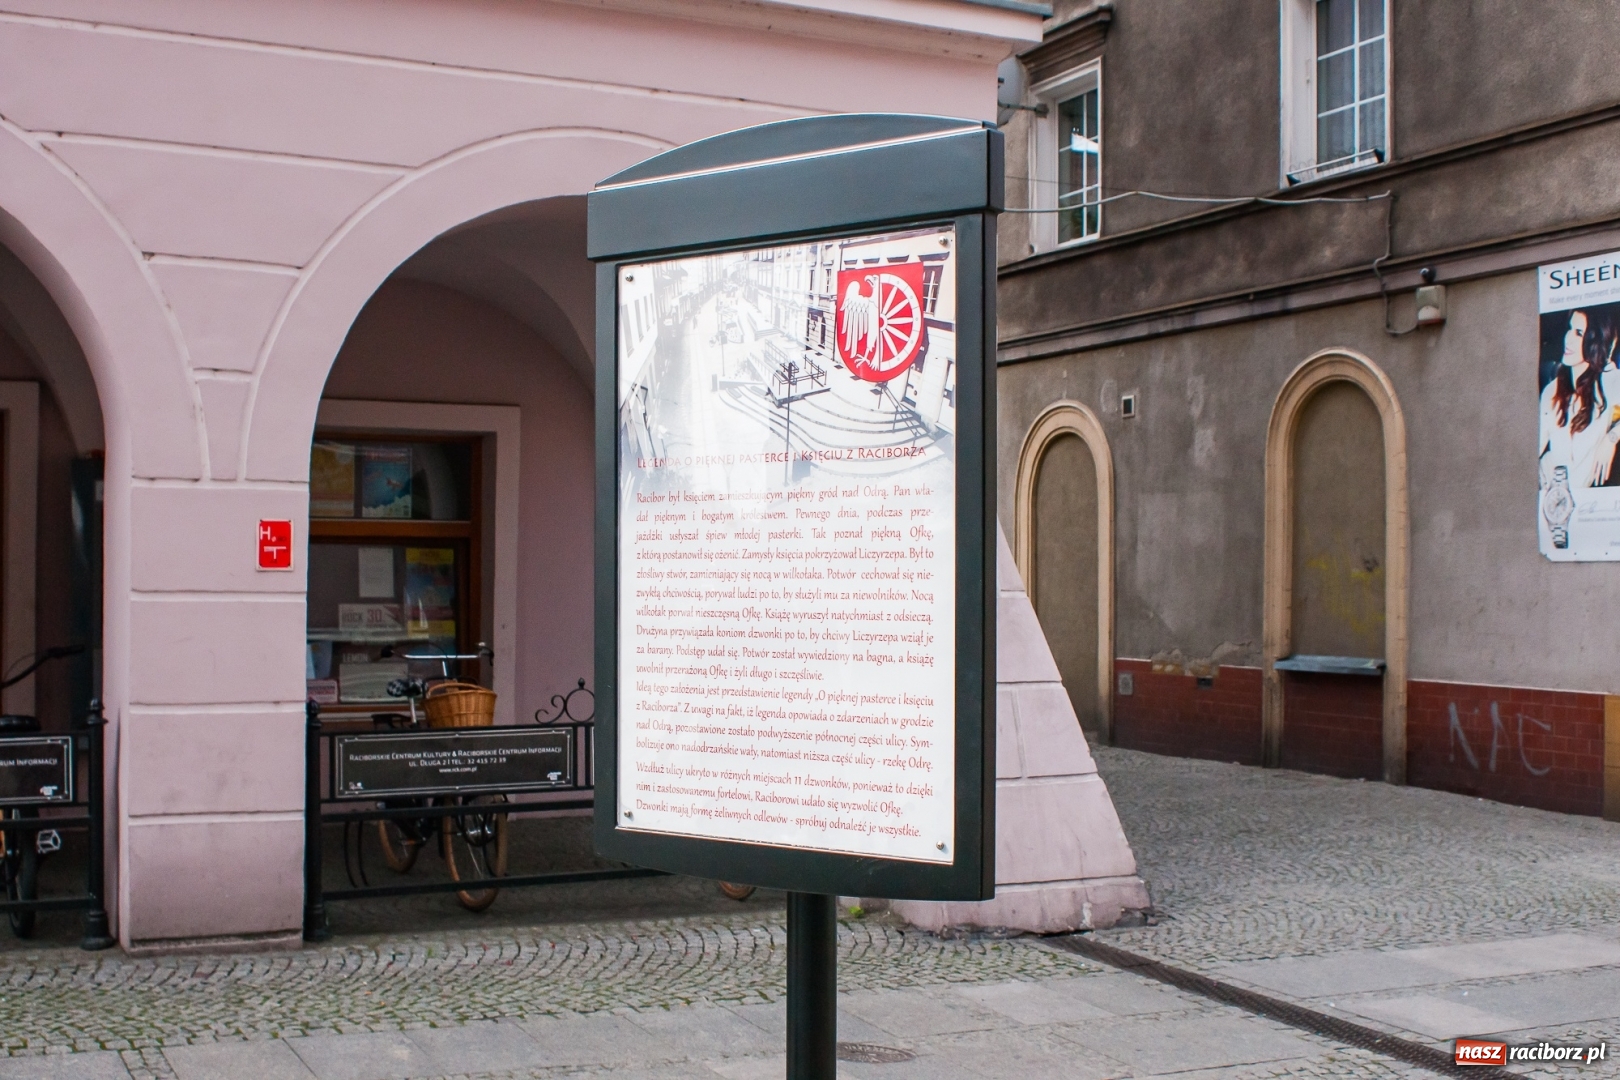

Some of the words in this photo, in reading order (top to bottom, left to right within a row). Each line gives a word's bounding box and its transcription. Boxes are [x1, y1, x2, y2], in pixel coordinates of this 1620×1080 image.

[636, 490, 665, 503] Racibor
[668, 490, 680, 506] był
[893, 484, 910, 496] Pan
[260, 526, 270, 540] H
[669, 528, 698, 544] usłyszał
[813, 526, 826, 538] Tak
[833, 525, 862, 542] poznał
[870, 525, 901, 541] piękną
[909, 524, 933, 541] Ofkę,
[641, 547, 661, 562] którą
[714, 548, 740, 559] ożenić.
[741, 546, 774, 563] Zamysły
[804, 546, 857, 562] pokrzyżował
[858, 547, 907, 562] Liczyrzepa.
[909, 545, 924, 562] Był
[666, 568, 687, 579] stwór,
[752, 571, 772, 582] nocą
[781, 566, 824, 579] wilkołaka.
[827, 568, 856, 579] Potwór
[860, 566, 900, 580] cechował
[636, 585, 661, 601] zwykłą
[737, 586, 757, 598] ludzi
[852, 587, 908, 601] niewolników.
[910, 589, 934, 604] Nocą
[635, 604, 666, 616] wilkołak
[741, 606, 762, 622] Ofkę.
[792, 606, 828, 624] wyruszył
[830, 607, 884, 625] natychmiast
[893, 608, 933, 625] odsieczą.
[636, 624, 668, 639] Drużyna
[669, 623, 714, 640] przywiązała
[716, 625, 746, 638] koniom
[747, 625, 782, 639] dzwonki
[852, 629, 898, 646] Liczyrzepa
[900, 629, 924, 646] wziął
[676, 643, 705, 659] Podstęp
[707, 644, 725, 657] udał
[742, 646, 770, 658] Potwór
[771, 646, 795, 659] został
[866, 649, 895, 667] bagna,
[906, 650, 934, 667] książę
[665, 663, 707, 678] przerażoną
[708, 663, 728, 680] Ofkę
[734, 664, 747, 681] żyli
[749, 665, 772, 682] długo
[778, 666, 824, 683] szczęśliwie.
[706, 684, 720, 699] jest
[721, 683, 780, 701] przedstawienie
[781, 686, 813, 704] legendy
[860, 692, 896, 708] pasterce
[903, 692, 934, 709] księciu
[690, 703, 714, 718] uwagi
[726, 703, 745, 720] fakt,
[755, 704, 786, 722] legenda
[787, 706, 827, 725] opowiada
[836, 709, 889, 725] zdarzeniach
[899, 712, 934, 731] grodzie
[674, 721, 726, 738] pozostawione
[727, 723, 755, 737] zostało
[757, 724, 813, 744] podwyższenie
[814, 728, 856, 747] północnej
[858, 733, 883, 748] części
[885, 732, 908, 750] ulicy.
[665, 742, 679, 751] ono
[681, 739, 738, 755] nadodrzańskie
[739, 743, 759, 760] wały,
[760, 746, 801, 760] natomiast
[803, 749, 830, 762] niższa
[831, 751, 853, 767] część
[882, 753, 906, 771] rzekę
[908, 754, 933, 773] Odrę.
[636, 760, 664, 774] Wzdłuż
[685, 764, 710, 781] ukryto
[720, 766, 750, 785] różnych
[752, 769, 792, 788] miejscach
[794, 775, 801, 785] 11
[803, 773, 850, 790] dzwonków,
[852, 779, 893, 796] ponieważ
[905, 781, 933, 799] dzięki
[635, 780, 651, 791] nim
[656, 782, 715, 798] zastosowanemu
[716, 785, 753, 804] fortelowi,
[754, 789, 799, 805] Raciborowi
[801, 793, 825, 808] udało
[839, 796, 878, 816] wyzwolić
[879, 799, 903, 819] Ofkę.
[636, 797, 668, 812] Dzwonki
[690, 802, 712, 820] formę
[714, 805, 751, 824] żeliwnych
[753, 808, 788, 824] odlewów
[794, 812, 827, 832] spróbuj
[828, 815, 867, 832] odnaleźć
[877, 820, 921, 841] wszystkie.
